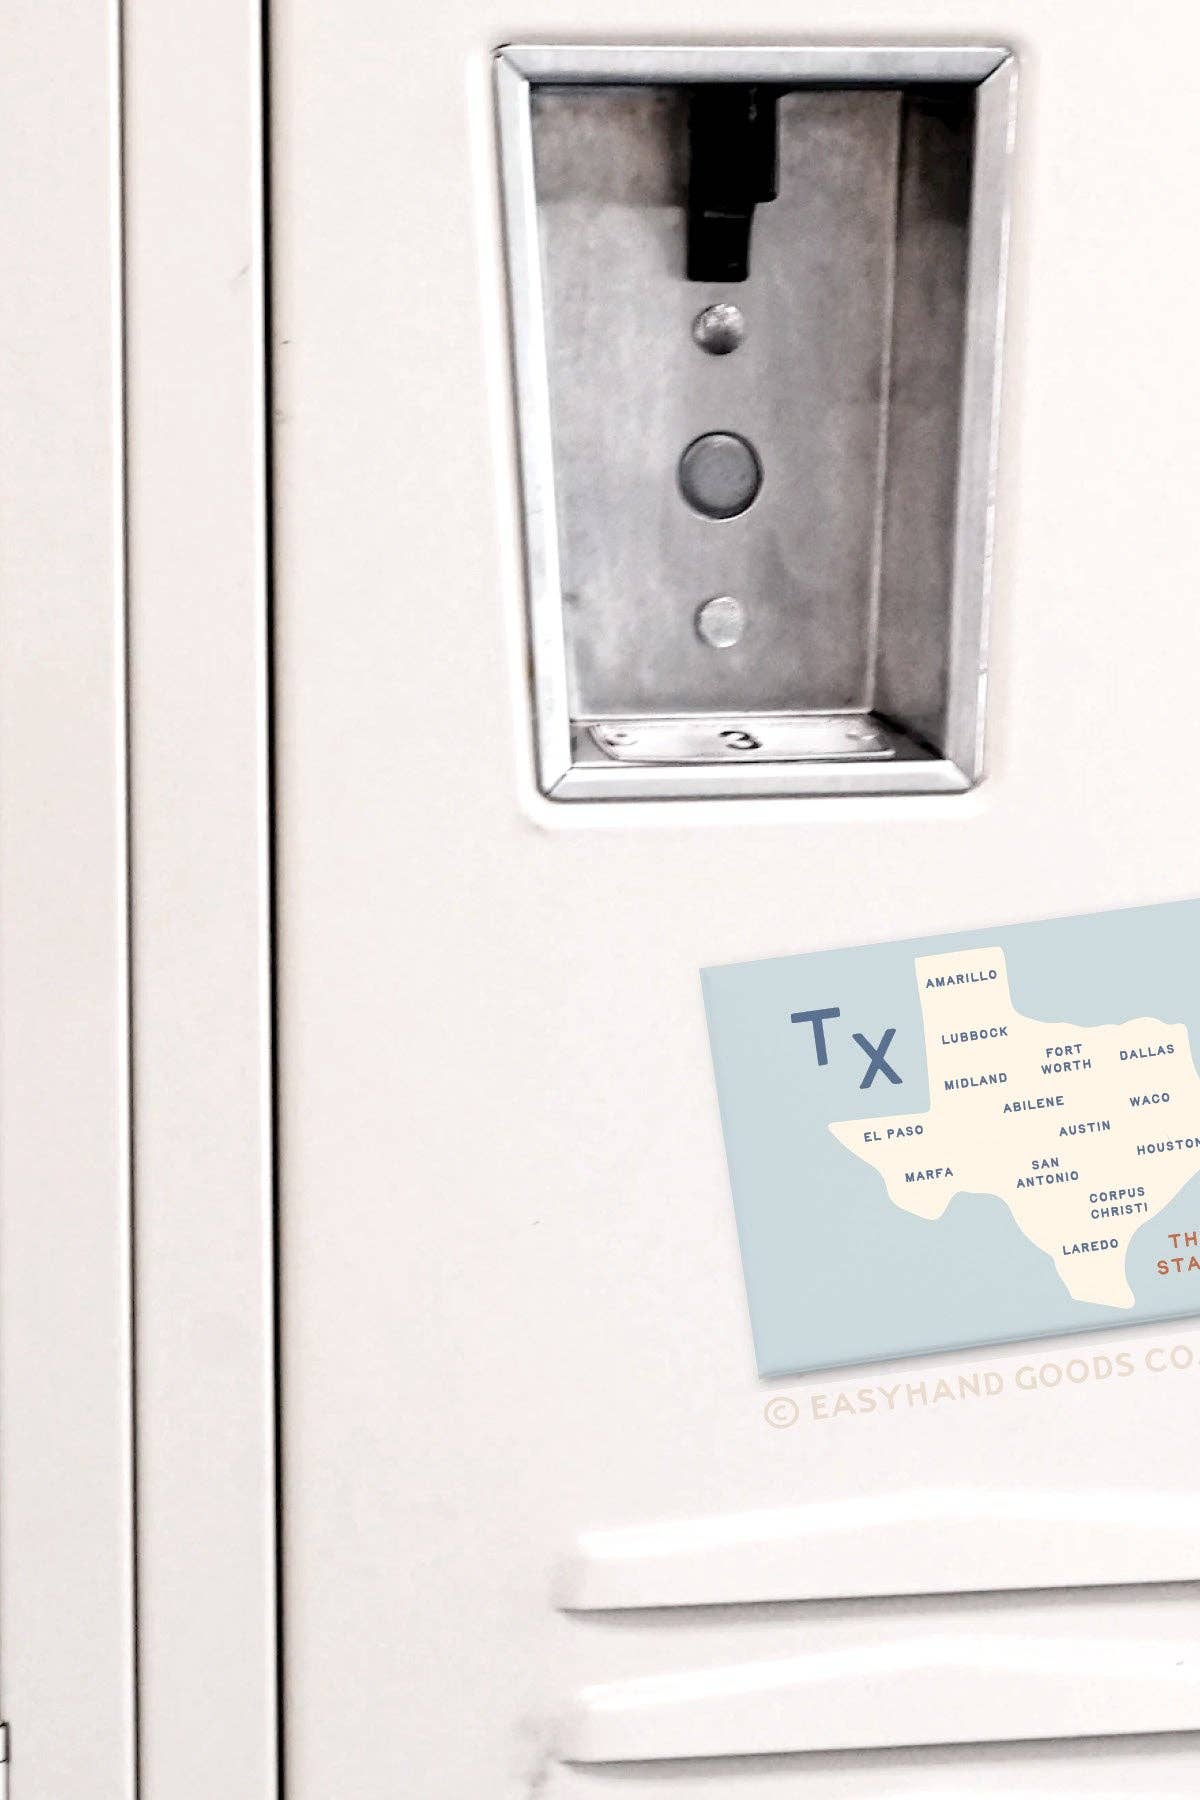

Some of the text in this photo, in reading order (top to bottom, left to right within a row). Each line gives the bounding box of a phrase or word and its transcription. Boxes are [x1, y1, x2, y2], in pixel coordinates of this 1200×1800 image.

[719, 730, 762, 750] 3
[925, 969, 997, 989] AMARILLO
[941, 1026, 1008, 1045] LUBBOCK
[1045, 1043, 1082, 1058] FORT
[1119, 1044, 1175, 1061] DALLAS
[1040, 1058, 1092, 1075] WORTH
[944, 1072, 1008, 1091] MIDLAND
[1003, 1095, 1065, 1114] ABILENE
[1129, 1092, 1170, 1107] WACO
[863, 1124, 924, 1143] EL PASO
[1059, 1120, 1111, 1137] AUSTIN
[1031, 1157, 1059, 1170] SAN
[904, 1167, 954, 1183] MARFA
[1016, 1170, 1079, 1189] ANTONIO
[1089, 1186, 1145, 1204] CORPUS
[1090, 1202, 1148, 1220] CHRISTI
[1062, 1238, 1119, 1256] LAREDO
